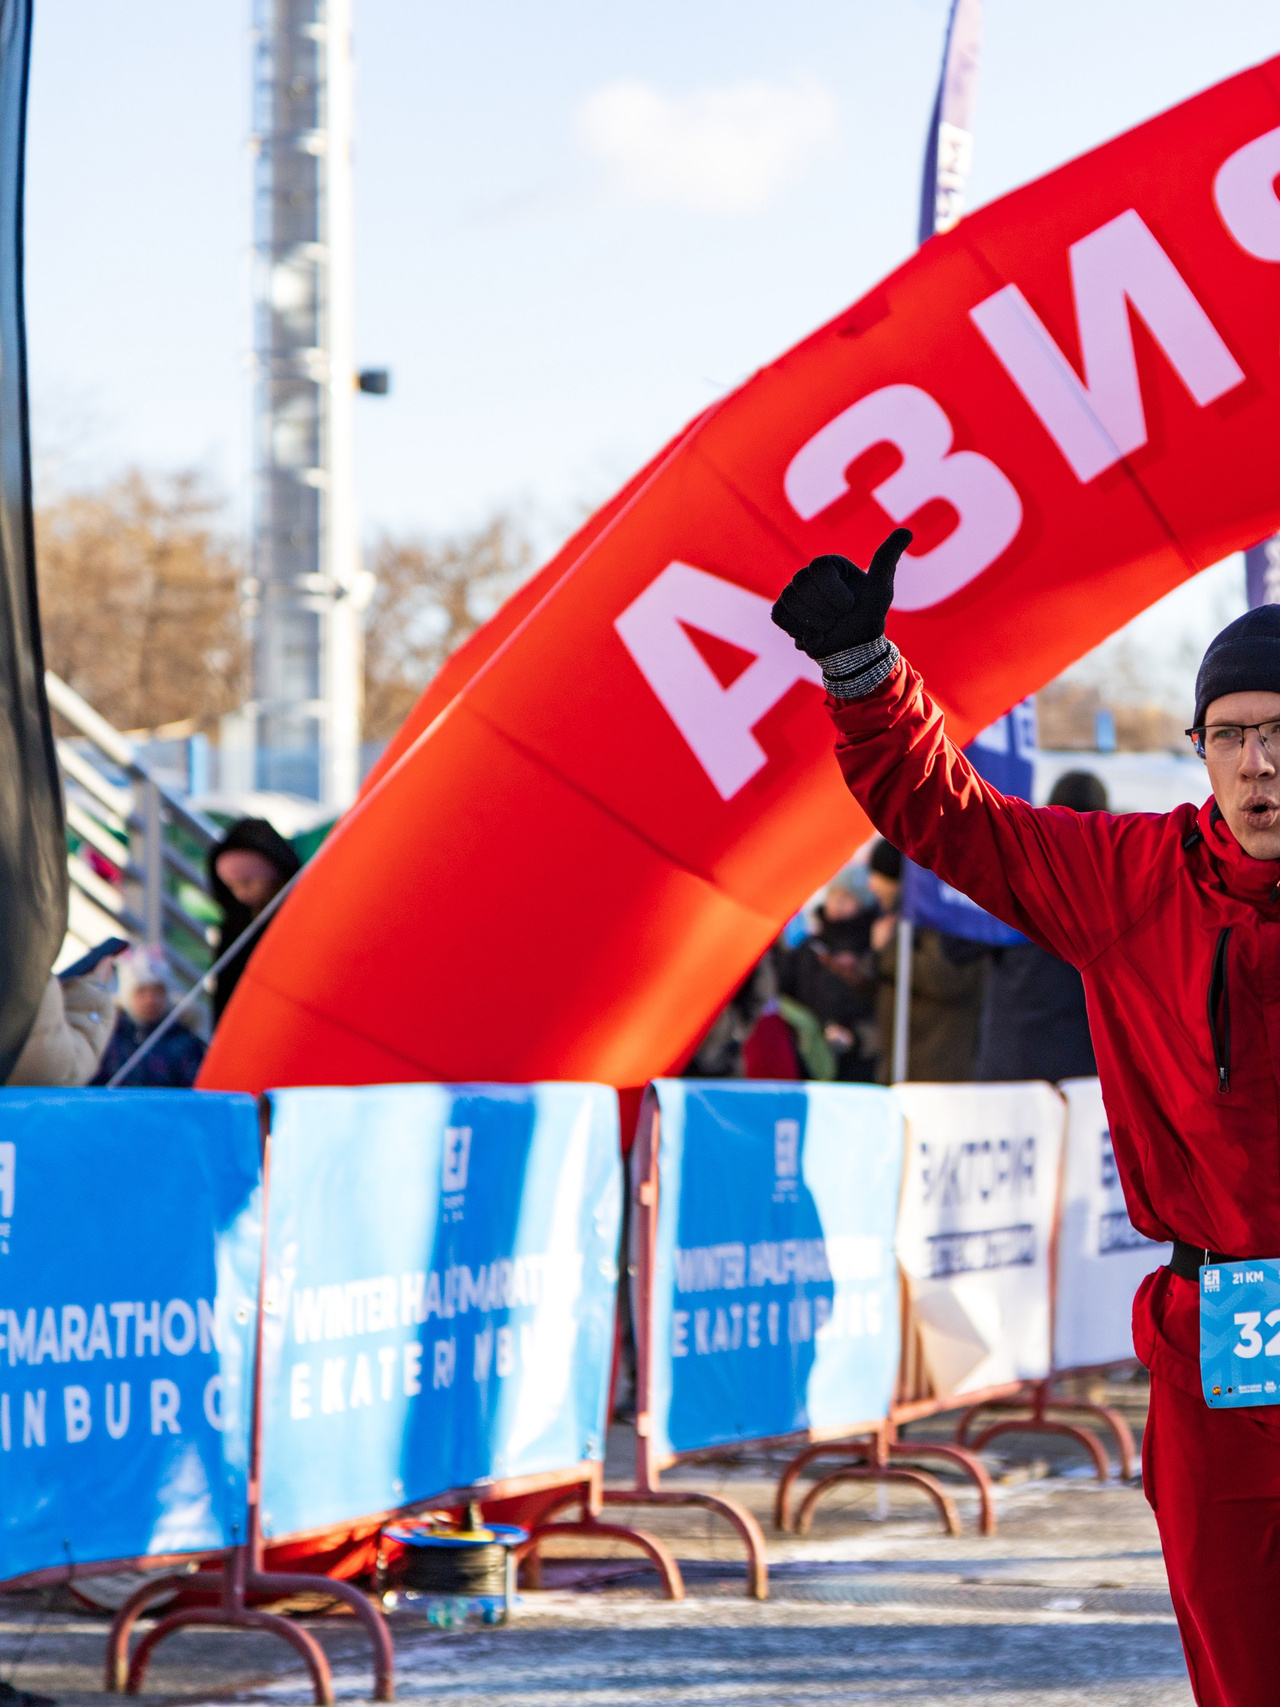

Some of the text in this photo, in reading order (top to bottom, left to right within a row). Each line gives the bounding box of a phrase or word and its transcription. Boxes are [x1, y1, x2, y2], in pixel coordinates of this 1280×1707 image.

[1232, 1270, 1264, 1284] 21 KM
[293, 1275, 397, 1344] WINTER
